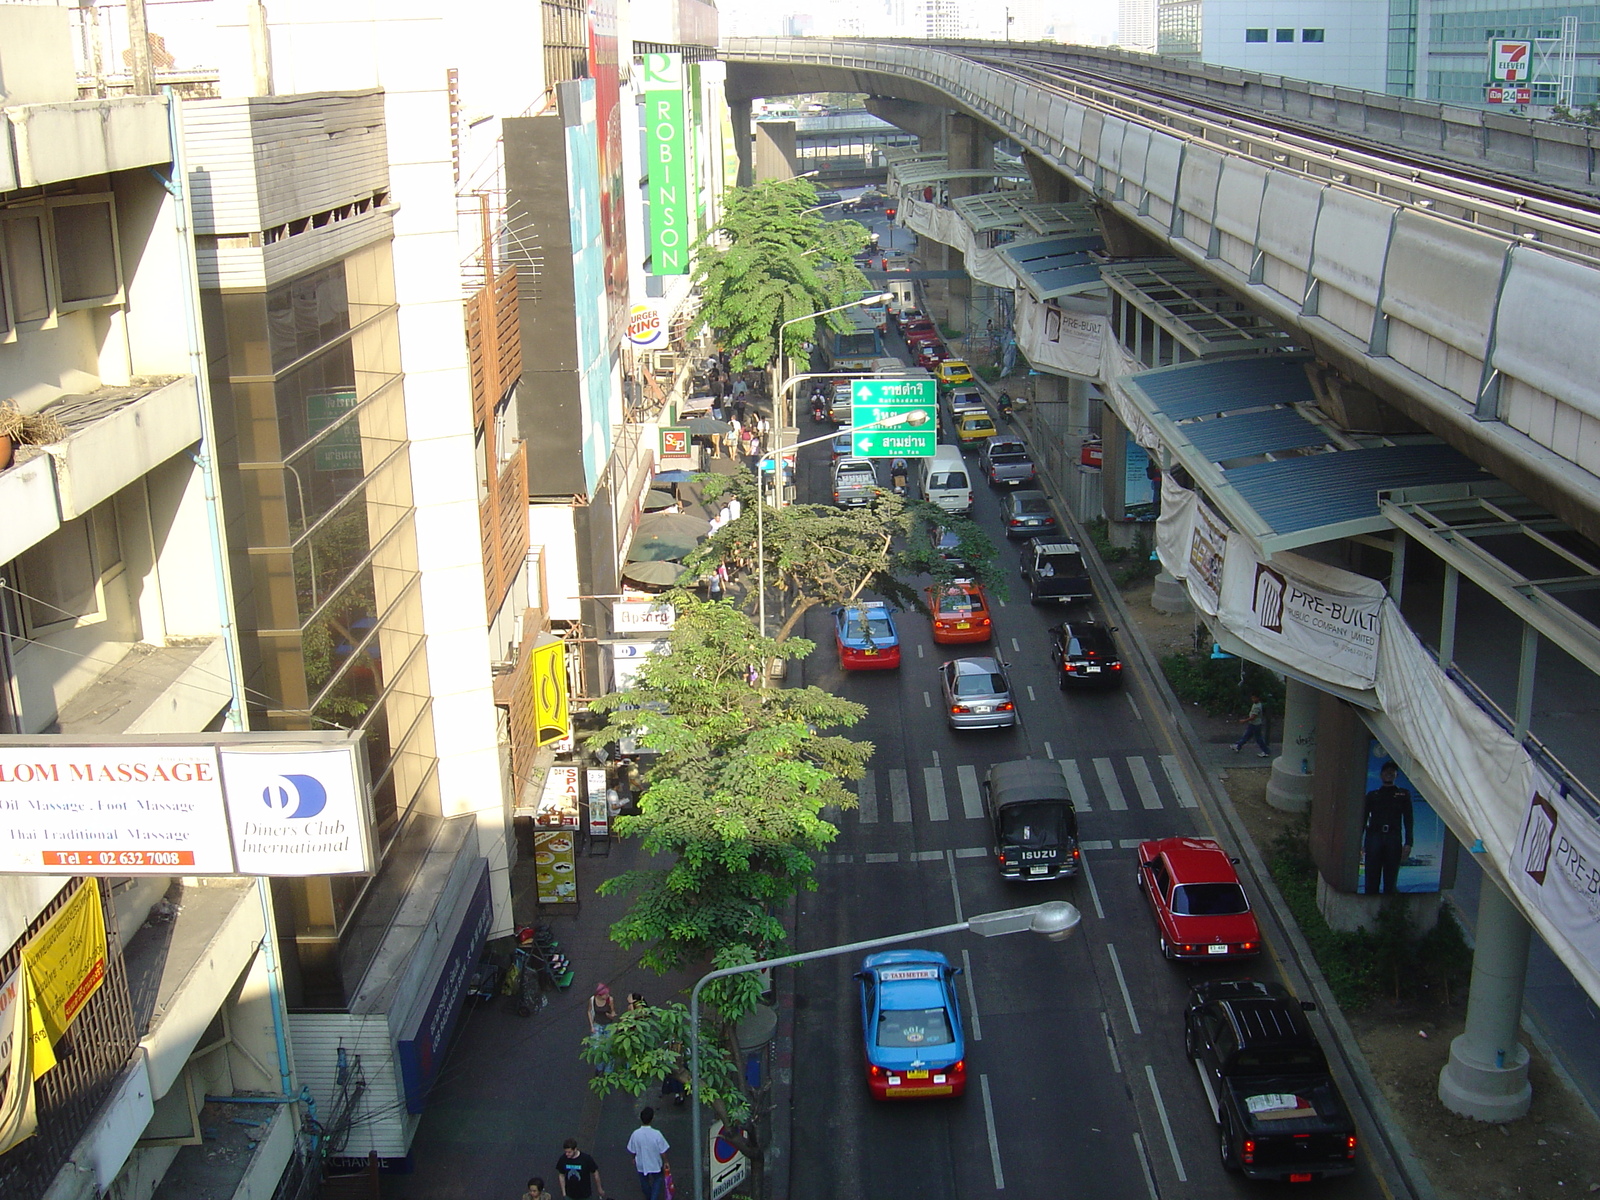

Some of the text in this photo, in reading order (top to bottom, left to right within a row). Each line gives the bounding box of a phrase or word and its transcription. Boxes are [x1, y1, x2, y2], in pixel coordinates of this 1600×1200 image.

[1503, 91, 1516, 101] 24
[656, 101, 679, 268] ROBINSON
[631, 310, 658, 323] URGER
[1062, 316, 1102, 334] PRE-BUILT
[627, 317, 660, 337] KING
[881, 382, 923, 396] ราชดำริ
[665, 433, 685, 451] S&P
[883, 435, 926, 448] สามย่าน
[1290, 588, 1377, 631] PRE-BUILT
[1287, 608, 1375, 646] PUBLIC COMPANY LIMITED
[69, 763, 213, 783] MASSAGE
[566, 769, 577, 793] SPA
[28, 800, 85, 812] Massage
[98, 800, 127, 811] Foot
[137, 800, 195, 812] Massage
[8, 829, 190, 841] Thai Traditional Massage
[245, 819, 345, 836] Diners Club
[242, 836, 349, 854] International
[57, 852, 80, 865] Tel
[99, 852, 117, 865] 02
[119, 852, 144, 865] 632
[146, 852, 180, 865] 7008
[1022, 850, 1057, 860] ISUZU
[1555, 836, 1600, 894] PRE-B
[903, 1025, 925, 1036] 6014
